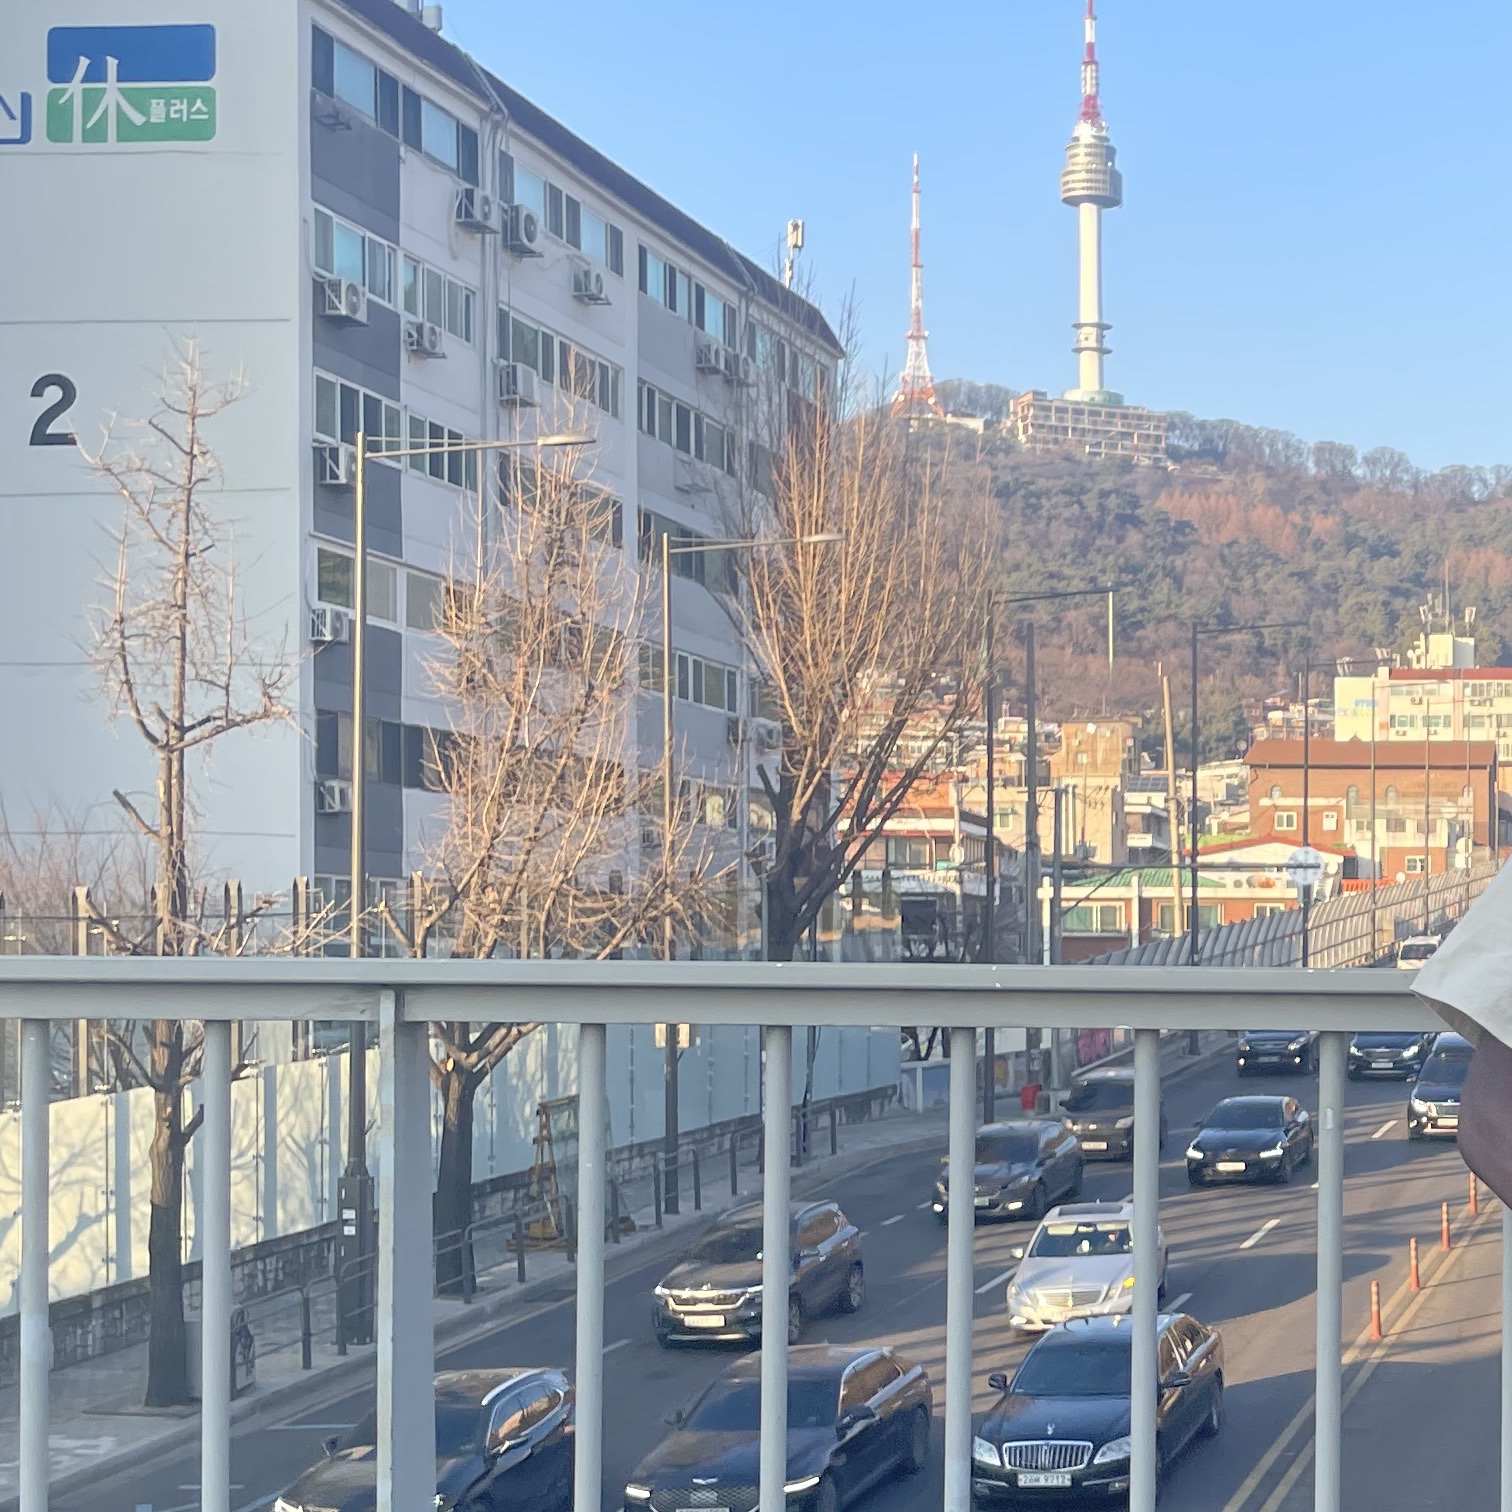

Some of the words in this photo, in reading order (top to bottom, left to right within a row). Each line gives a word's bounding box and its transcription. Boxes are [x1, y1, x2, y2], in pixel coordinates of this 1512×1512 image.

[59, 55, 147, 144] 休
[150, 98, 210, 123] 플러스
[29, 373, 77, 446] 2
